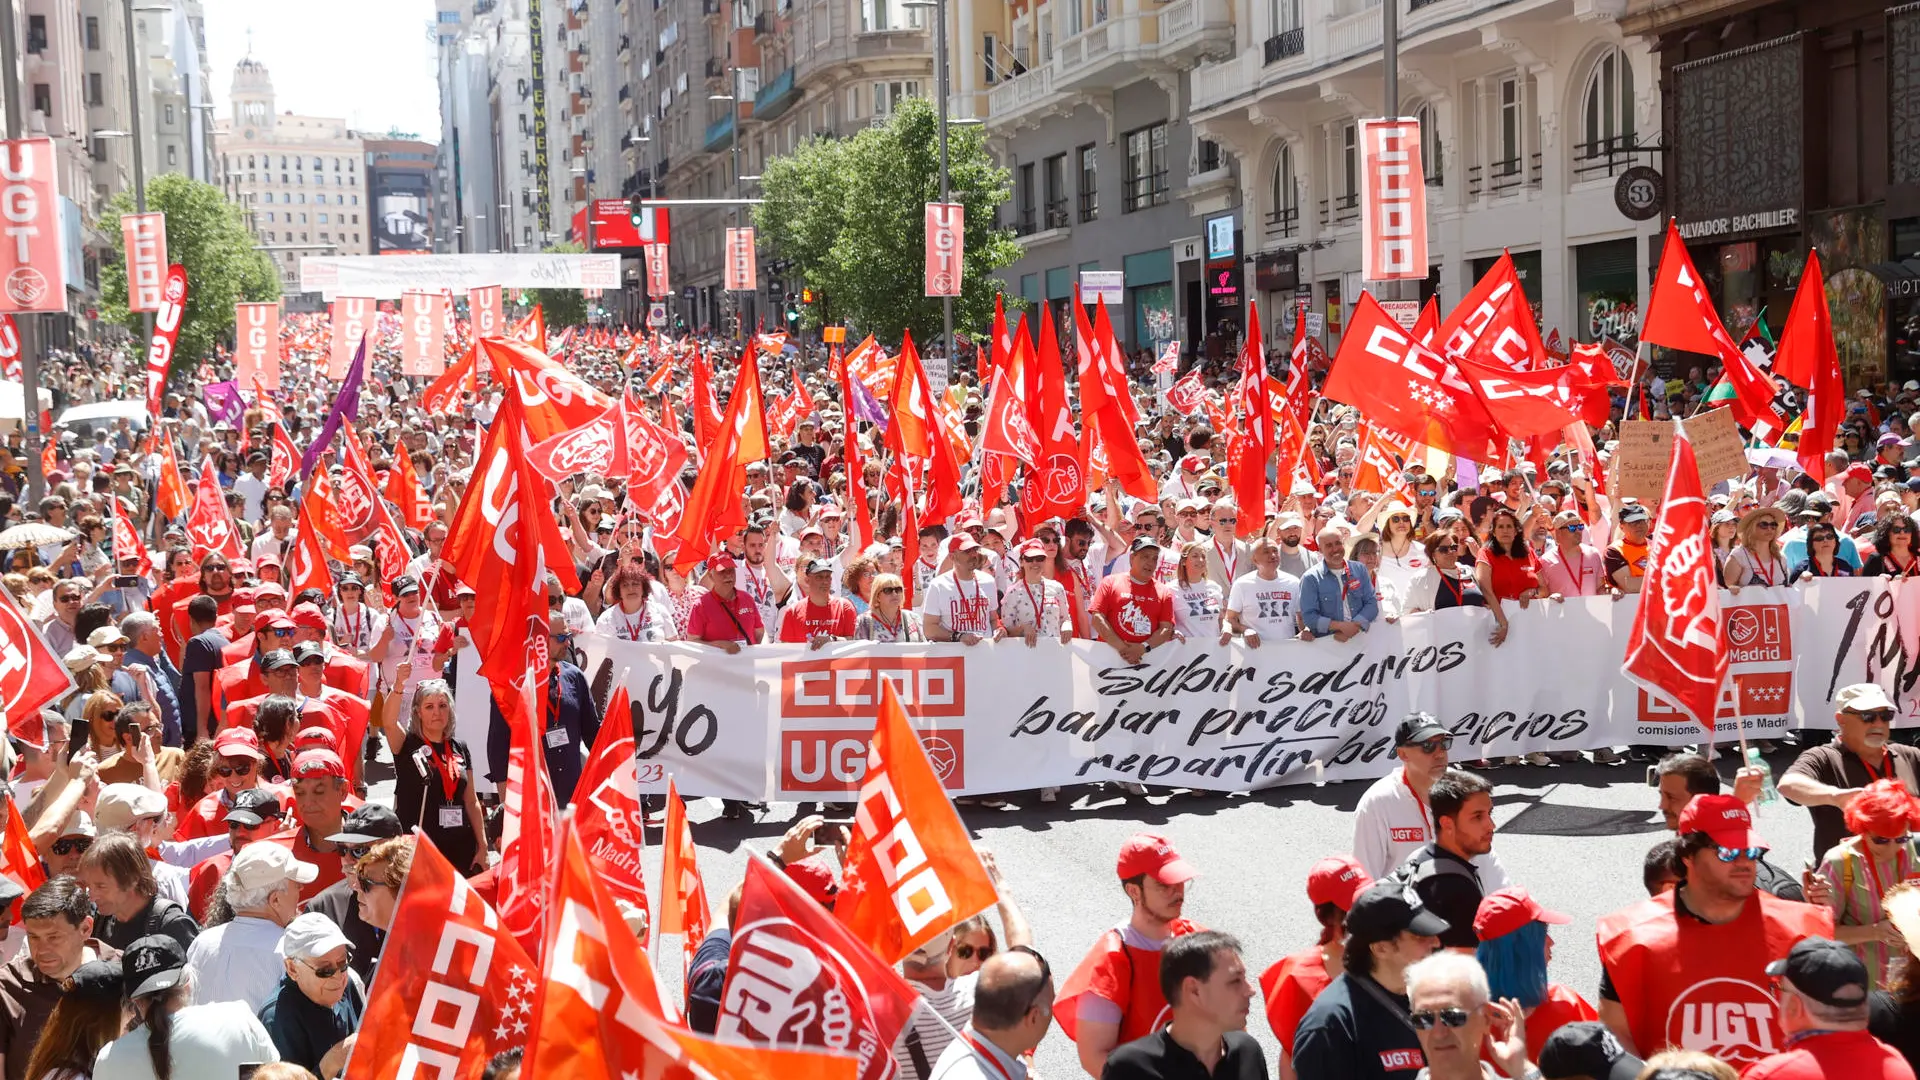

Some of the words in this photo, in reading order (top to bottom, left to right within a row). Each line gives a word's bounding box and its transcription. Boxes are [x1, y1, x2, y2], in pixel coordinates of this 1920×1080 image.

[529, 0, 543, 80] HOTEL
[0, 143, 39, 264] UGT
[1377, 127, 1413, 273] CCOO
[1732, 208, 1797, 232] BACHILLER
[131, 216, 161, 309] CCOO
[936, 207, 954, 271] UGT
[1185, 244, 1194, 257] 61
[651, 246, 663, 286] UGT
[248, 305, 267, 370] UGT
[414, 294, 433, 357] UGT
[1258, 641, 1467, 704] salarios
[1729, 645, 1780, 663] Madrid
[794, 669, 954, 706] CCOO
[1009, 696, 1182, 743] bajar
[1187, 692, 1387, 746] precios
[1075, 734, 1339, 783] repartir
[1323, 707, 1588, 769] beficios
[1637, 724, 1701, 737] comisiones
[1740, 718, 1754, 730] de
[1756, 716, 1788, 729] Madri
[791, 738, 873, 783] UG
[1391, 829, 1411, 841] UGT
[1680, 1002, 1781, 1054] UGT
[1381, 1050, 1411, 1068] UGT
